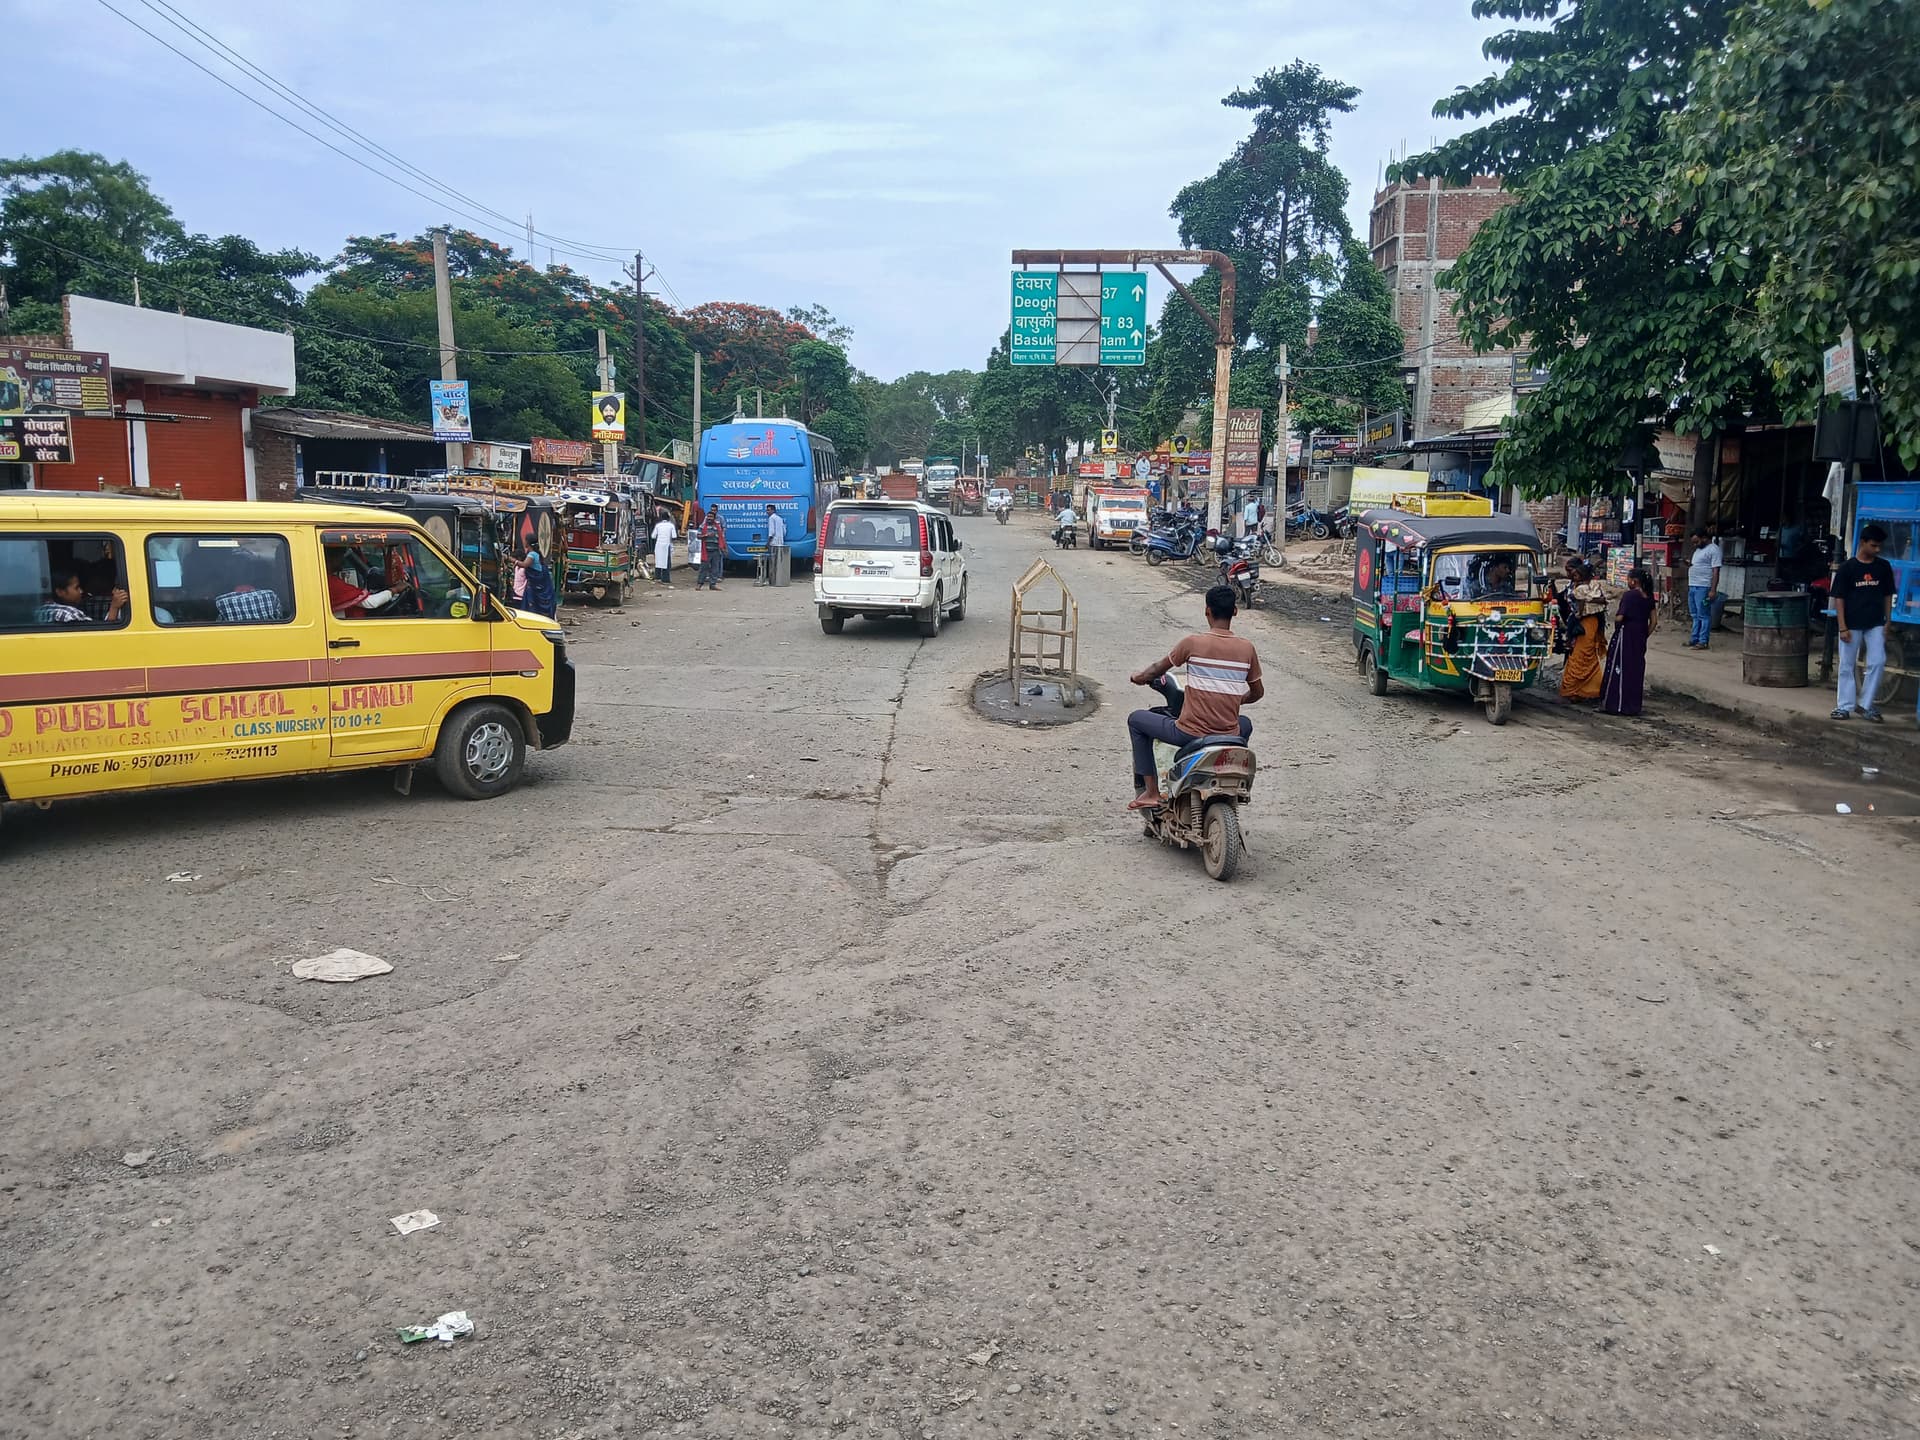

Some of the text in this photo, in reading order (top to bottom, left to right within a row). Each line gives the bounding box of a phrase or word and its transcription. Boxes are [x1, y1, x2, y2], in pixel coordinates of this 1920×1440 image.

[1015, 273, 1052, 290] देवघर
[1102, 287, 1117, 300] 37
[1014, 295, 1056, 311] Deogh
[1015, 311, 1133, 334] बासुकी म 83
[1229, 416, 1259, 431] Hotel
[35, 447, 60, 461] सेंटर
[746, 503, 764, 511] BUS
[35, 701, 152, 735] PUBLIC
[180, 692, 296, 724] SCHOOL
[331, 683, 414, 712] JAMUI
[332, 716, 346, 728] TO
